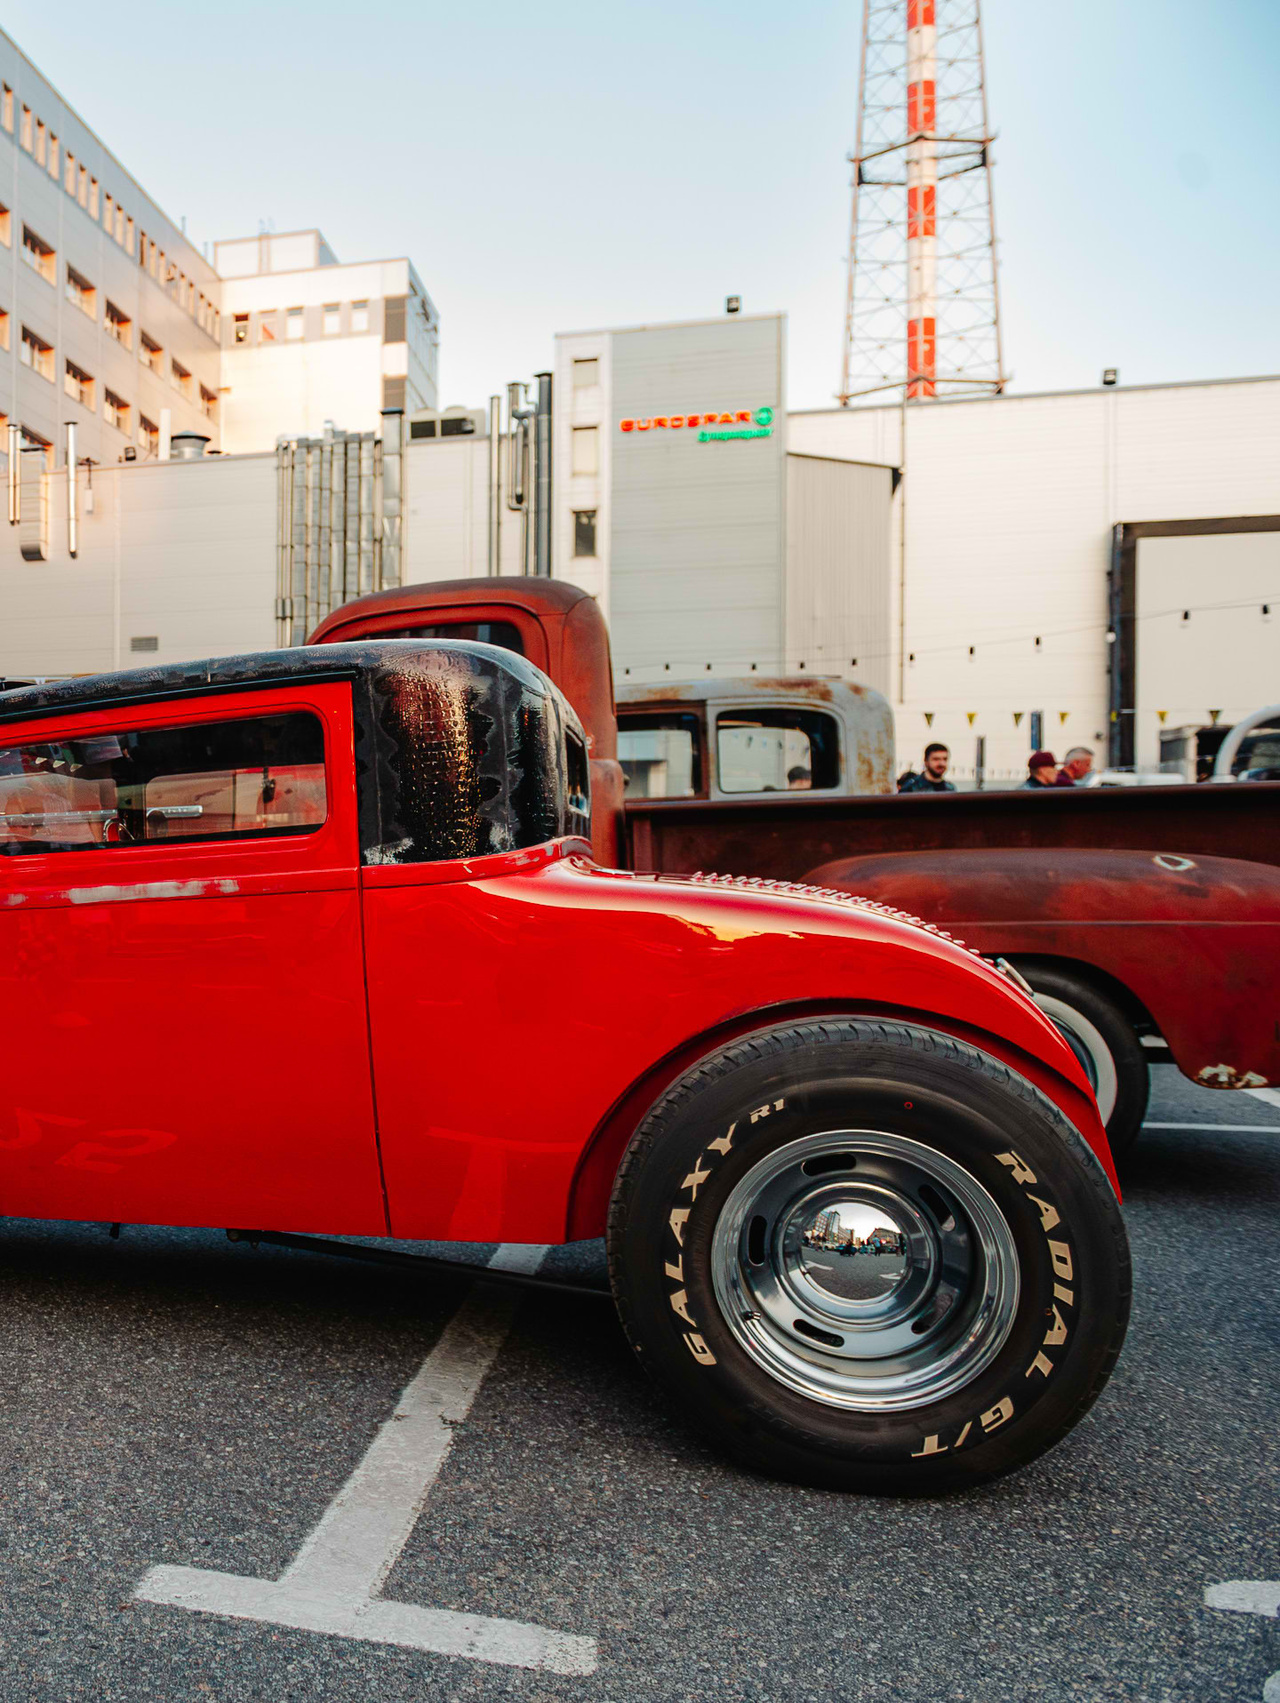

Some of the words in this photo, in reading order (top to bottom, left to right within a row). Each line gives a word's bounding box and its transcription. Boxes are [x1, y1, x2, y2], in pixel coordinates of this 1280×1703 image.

[620, 410, 752, 432] EUROSPAR
[665, 1122, 736, 1366] GALAXY
[749, 1098, 786, 1124] R1
[993, 1150, 1074, 1378] RADIAL
[911, 1396, 1014, 1458] G/T
